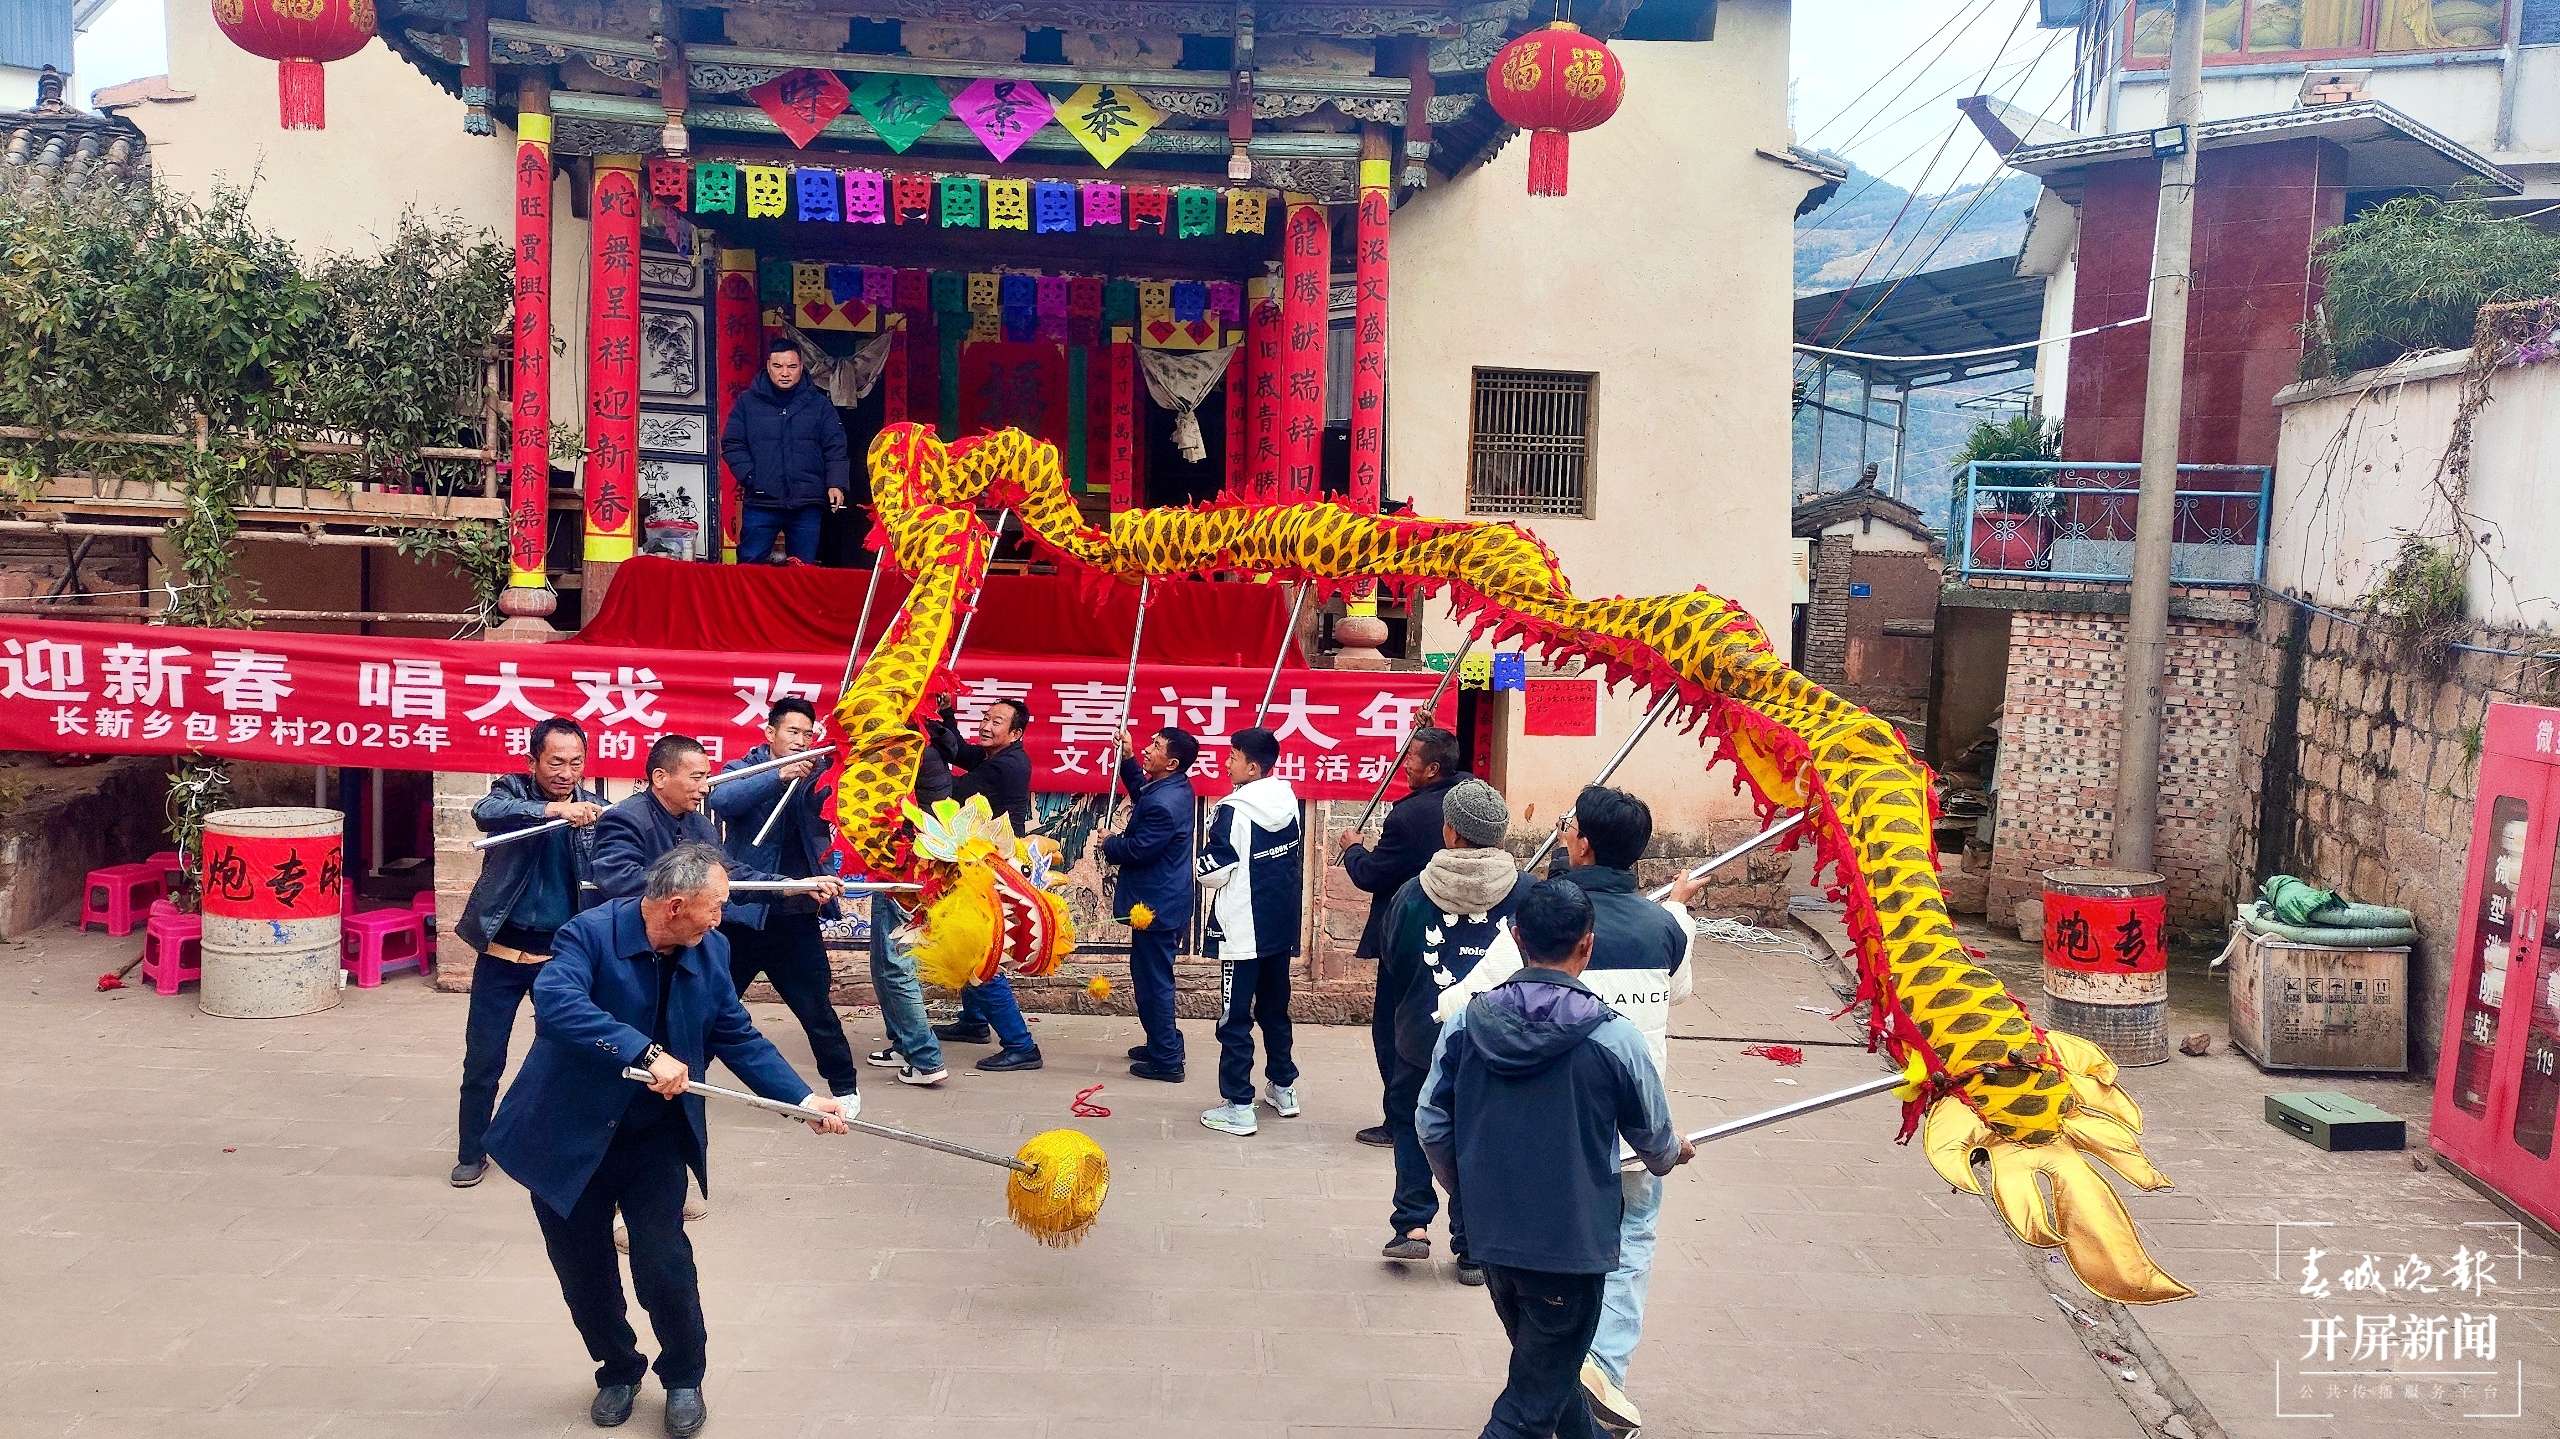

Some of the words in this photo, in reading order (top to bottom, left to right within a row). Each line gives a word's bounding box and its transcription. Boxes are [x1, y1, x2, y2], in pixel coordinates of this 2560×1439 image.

[1565, 48, 1606, 100] 福
[976, 81, 1032, 138] 景
[1081, 84, 1138, 142] 泰
[591, 185, 636, 524] 蛇舞呈祥迎新春
[0, 638, 294, 713] 迎新春
[358, 658, 667, 729] 唱大戏
[731, 671, 1438, 754] 欢喜喜过大年
[49, 705, 451, 753] 长新乡包罗村2025年
[201, 845, 342, 909] 炮专用
[2536, 1047, 2555, 1077] 119
